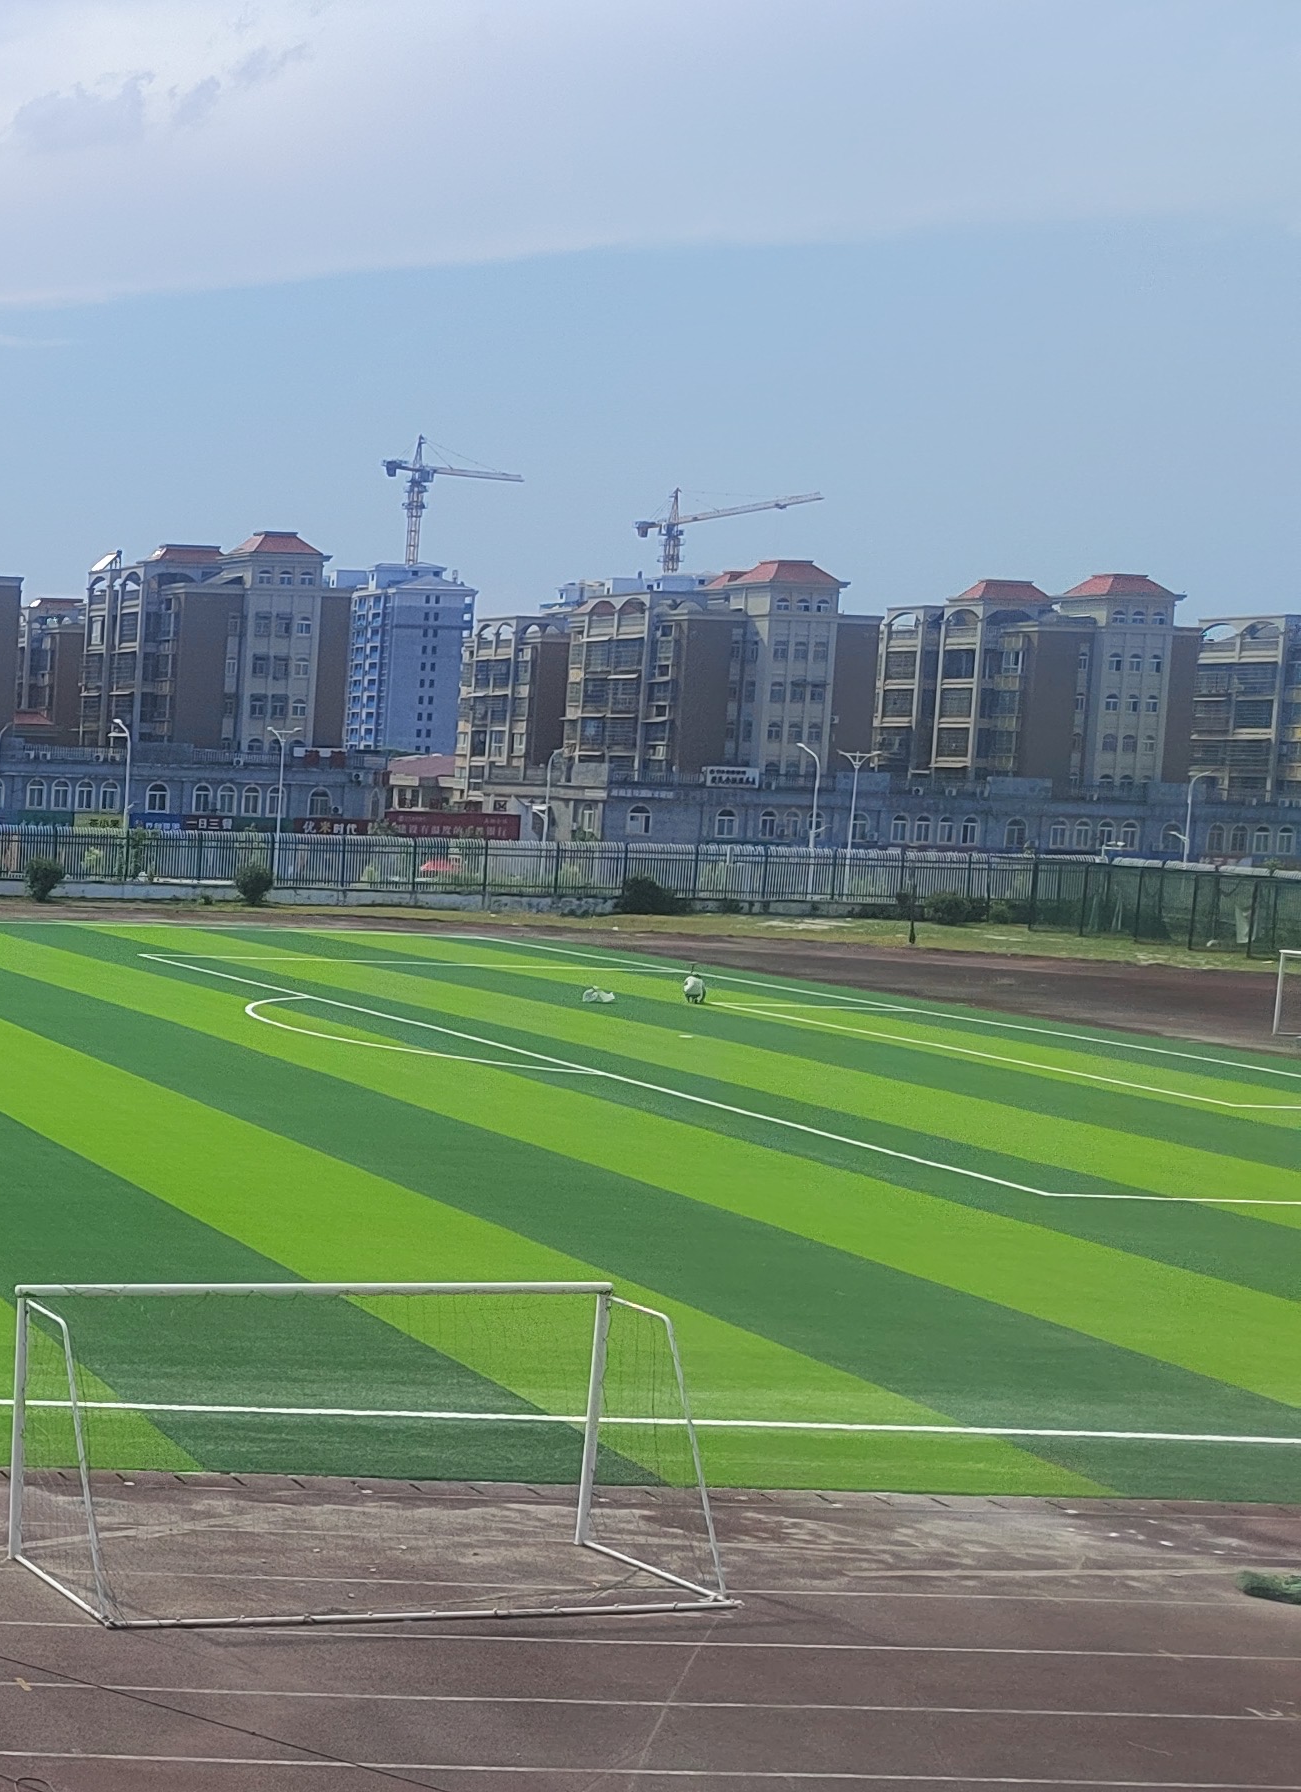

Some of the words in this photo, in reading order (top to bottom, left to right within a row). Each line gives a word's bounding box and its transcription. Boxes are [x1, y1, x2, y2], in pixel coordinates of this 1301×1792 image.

[186, 817, 233, 830] 一日三餐
[302, 820, 357, 835] 优米时代
